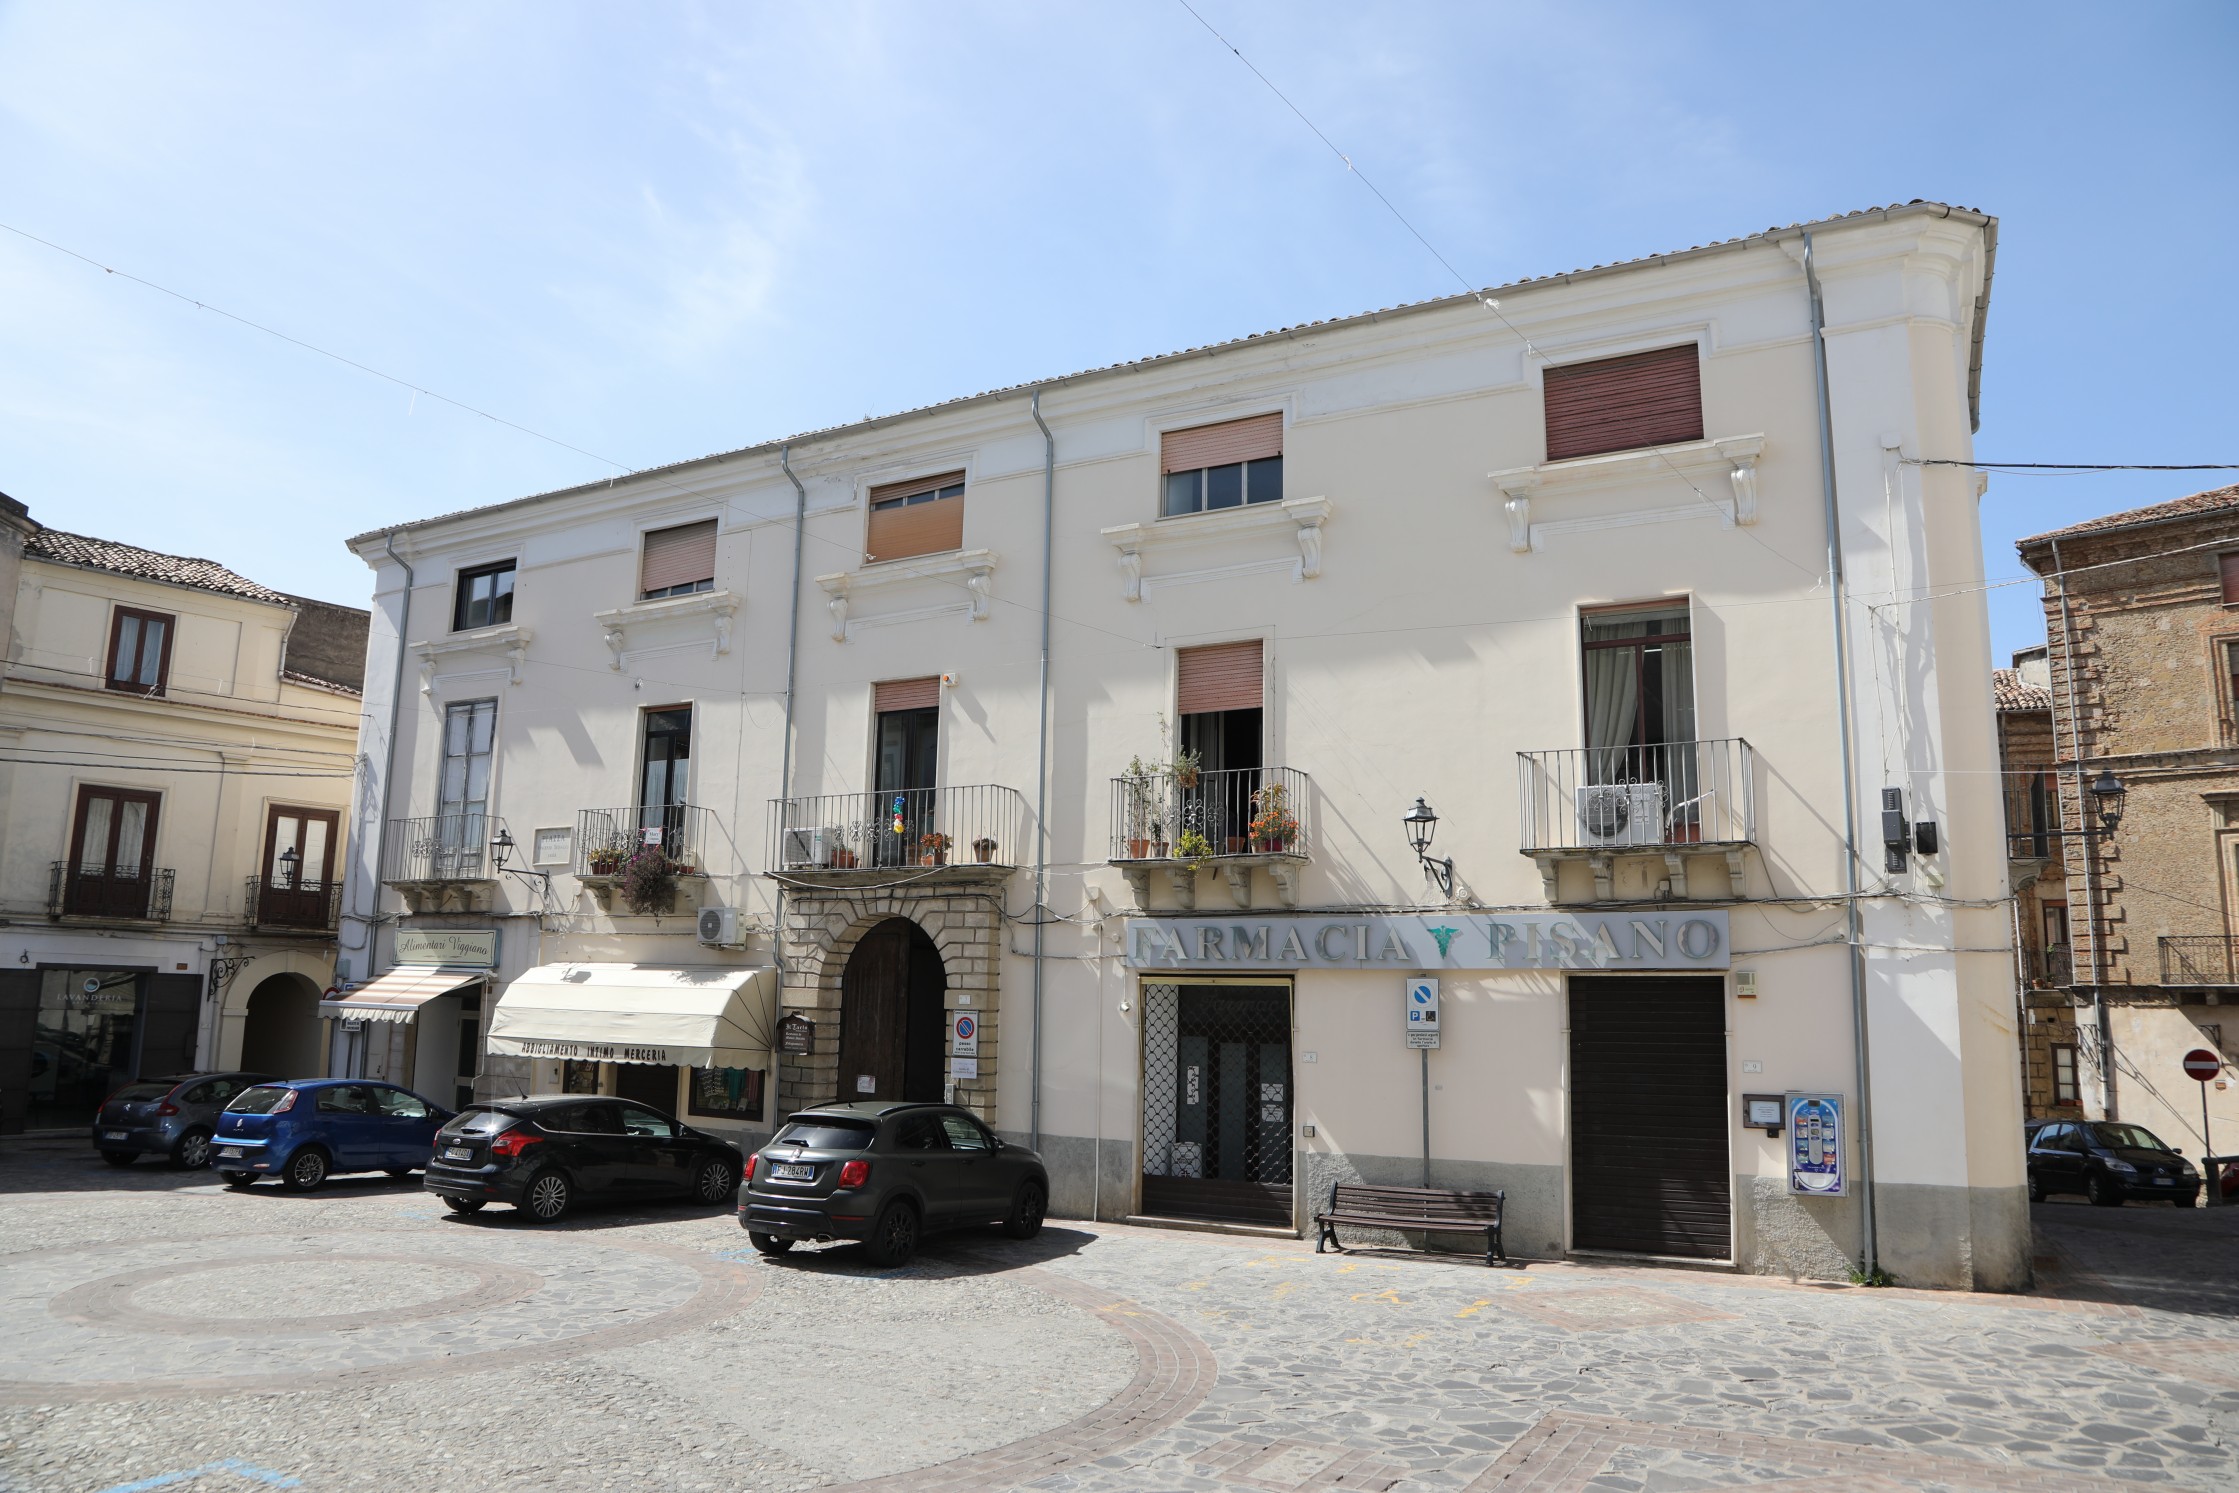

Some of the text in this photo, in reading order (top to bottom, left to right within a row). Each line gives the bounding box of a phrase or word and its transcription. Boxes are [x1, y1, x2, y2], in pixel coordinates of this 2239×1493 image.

[541, 834, 566, 842] PIAZZA
[398, 935, 488, 956] Alimentari Viggiano
[1132, 919, 1720, 961] FARMACIA PISANO
[57, 993, 123, 1001] LAVANDERIA
[521, 1041, 667, 1062] ABBIGLIAMENTO INTIMO MERCERIA
